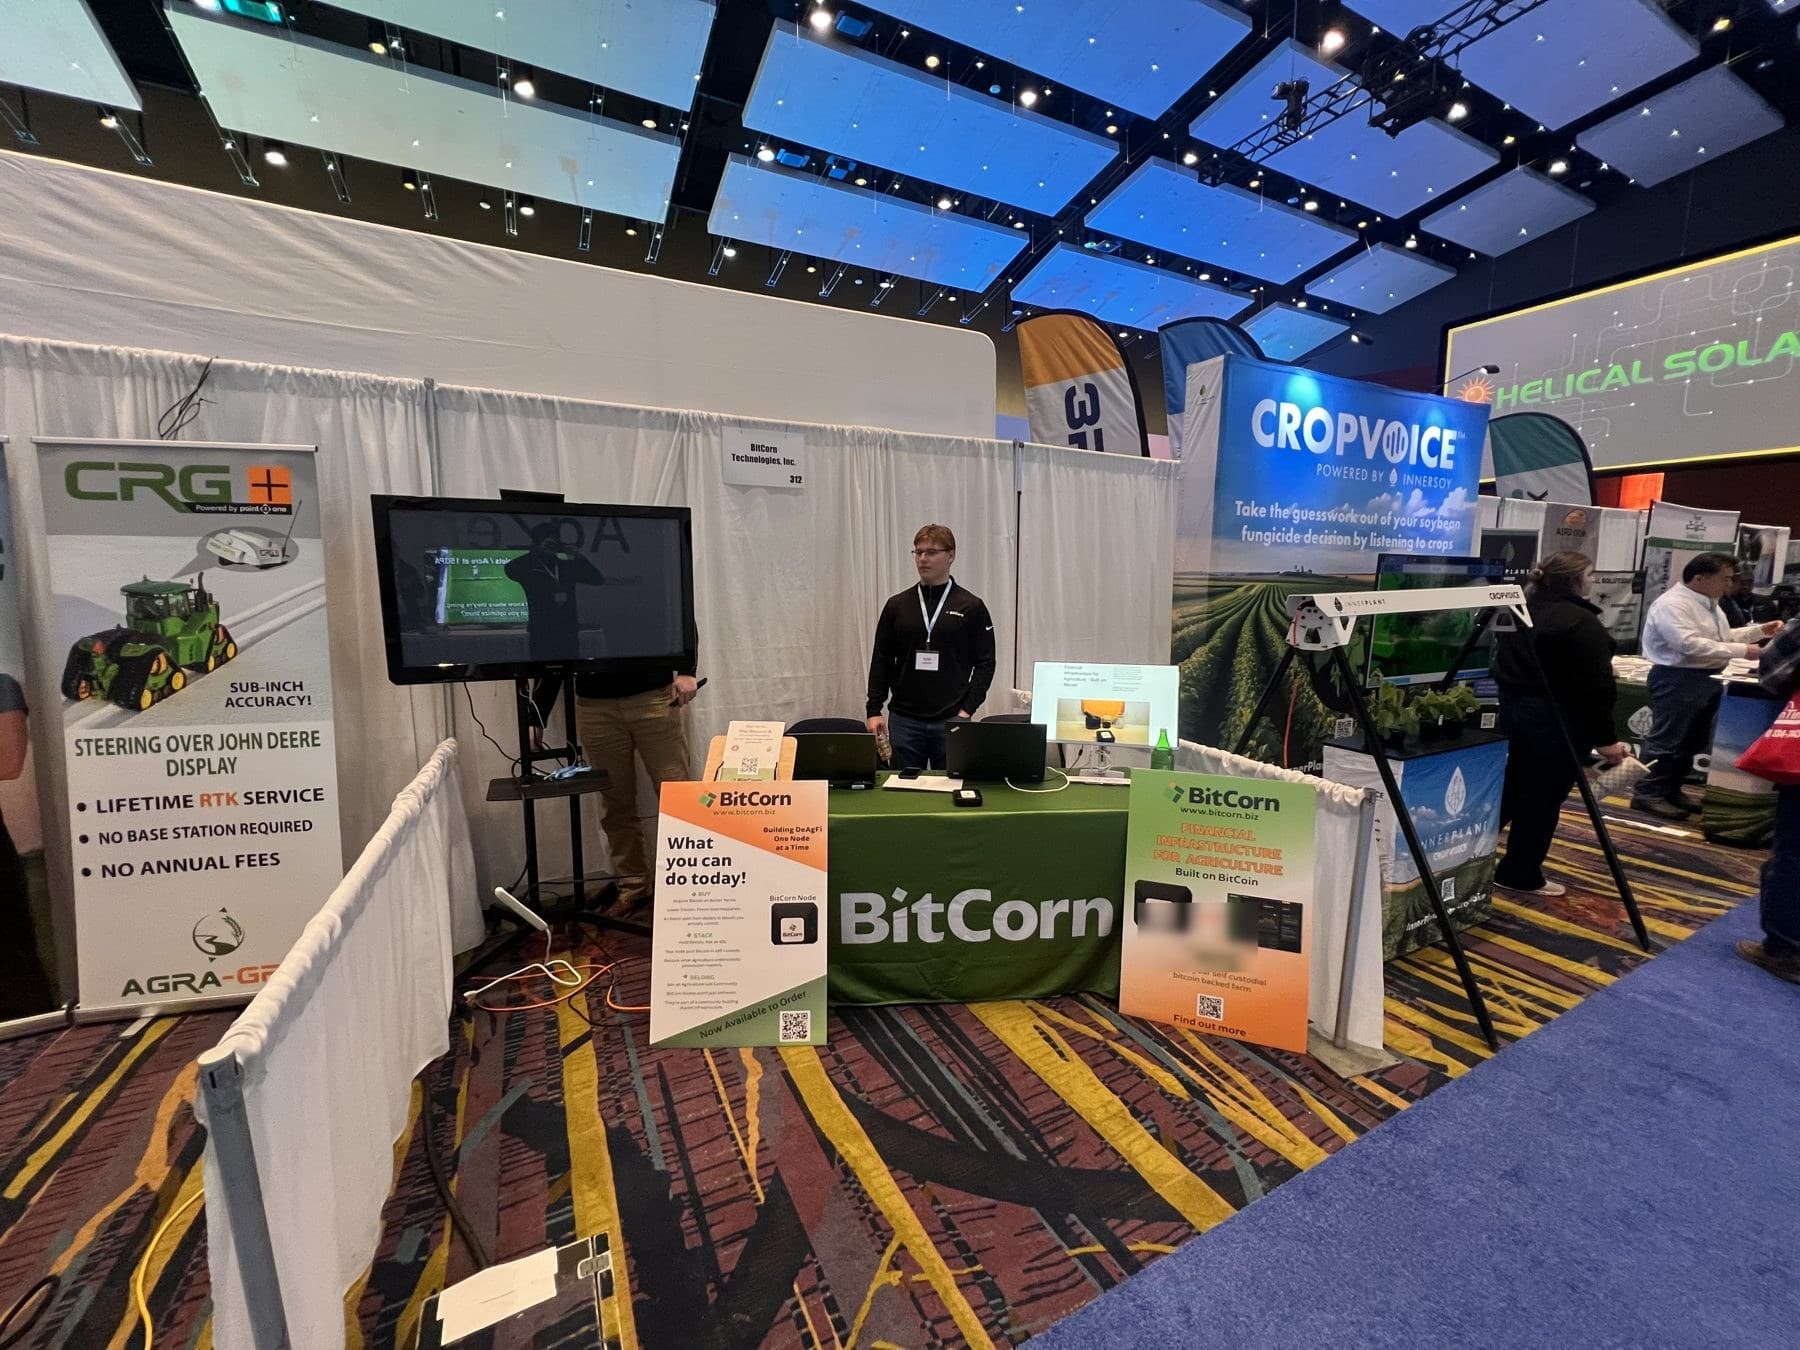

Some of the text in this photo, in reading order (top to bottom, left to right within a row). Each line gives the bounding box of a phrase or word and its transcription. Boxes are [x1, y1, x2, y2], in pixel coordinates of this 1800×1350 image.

[1496, 331, 1800, 409] HELICAL SOLA
[1251, 398, 1457, 470] CROPVOICE
[750, 443, 778, 454] BitCorn
[732, 453, 797, 466] Technologies, Inc.
[789, 475, 802, 484] 312
[1316, 463, 1452, 489] POWERED BY INNERSOY
[64, 461, 232, 513] CRG
[195, 504, 227, 512] Powered
[228, 505, 237, 513] by
[1235, 500, 1461, 532] Take the guesswork out of your soybean
[1241, 525, 1453, 552] fungicide decision by listening to crops
[230, 681, 304, 694] SUB-INCH
[225, 695, 312, 708] ACCURACY!
[75, 730, 321, 757] STEERING OVER JOHN DEERE
[166, 756, 238, 777] DISPLAY
[96, 787, 325, 814] LIFETIME RTK SERVICE
[720, 791, 792, 807] BitCorn
[1189, 786, 1280, 812] BitCorn
[1180, 807, 1260, 820] www.bitcorn.biz
[99, 820, 313, 845] NO BASE STATION REQUIRED
[763, 826, 823, 834] Building DeAgFi
[1182, 822, 1256, 841] FINANCIAL
[667, 836, 714, 850] What
[1156, 834, 1282, 860] INFRASTRUCTURE
[101, 852, 281, 878] NO ANNUAL FEES
[666, 857, 732, 871] you can
[1153, 849, 1284, 876] FOR AGRICULTURE
[665, 872, 746, 888] do today!
[1175, 867, 1259, 886] Built on BitCoin
[840, 886, 1114, 945] BitCorn
[1173, 972, 1200, 982] bitcoin
[1201, 977, 1230, 989] backed
[1228, 973, 1267, 986] custodial
[699, 991, 807, 1039] Now Available to Order
[1173, 1014, 1247, 1037] Find out more
